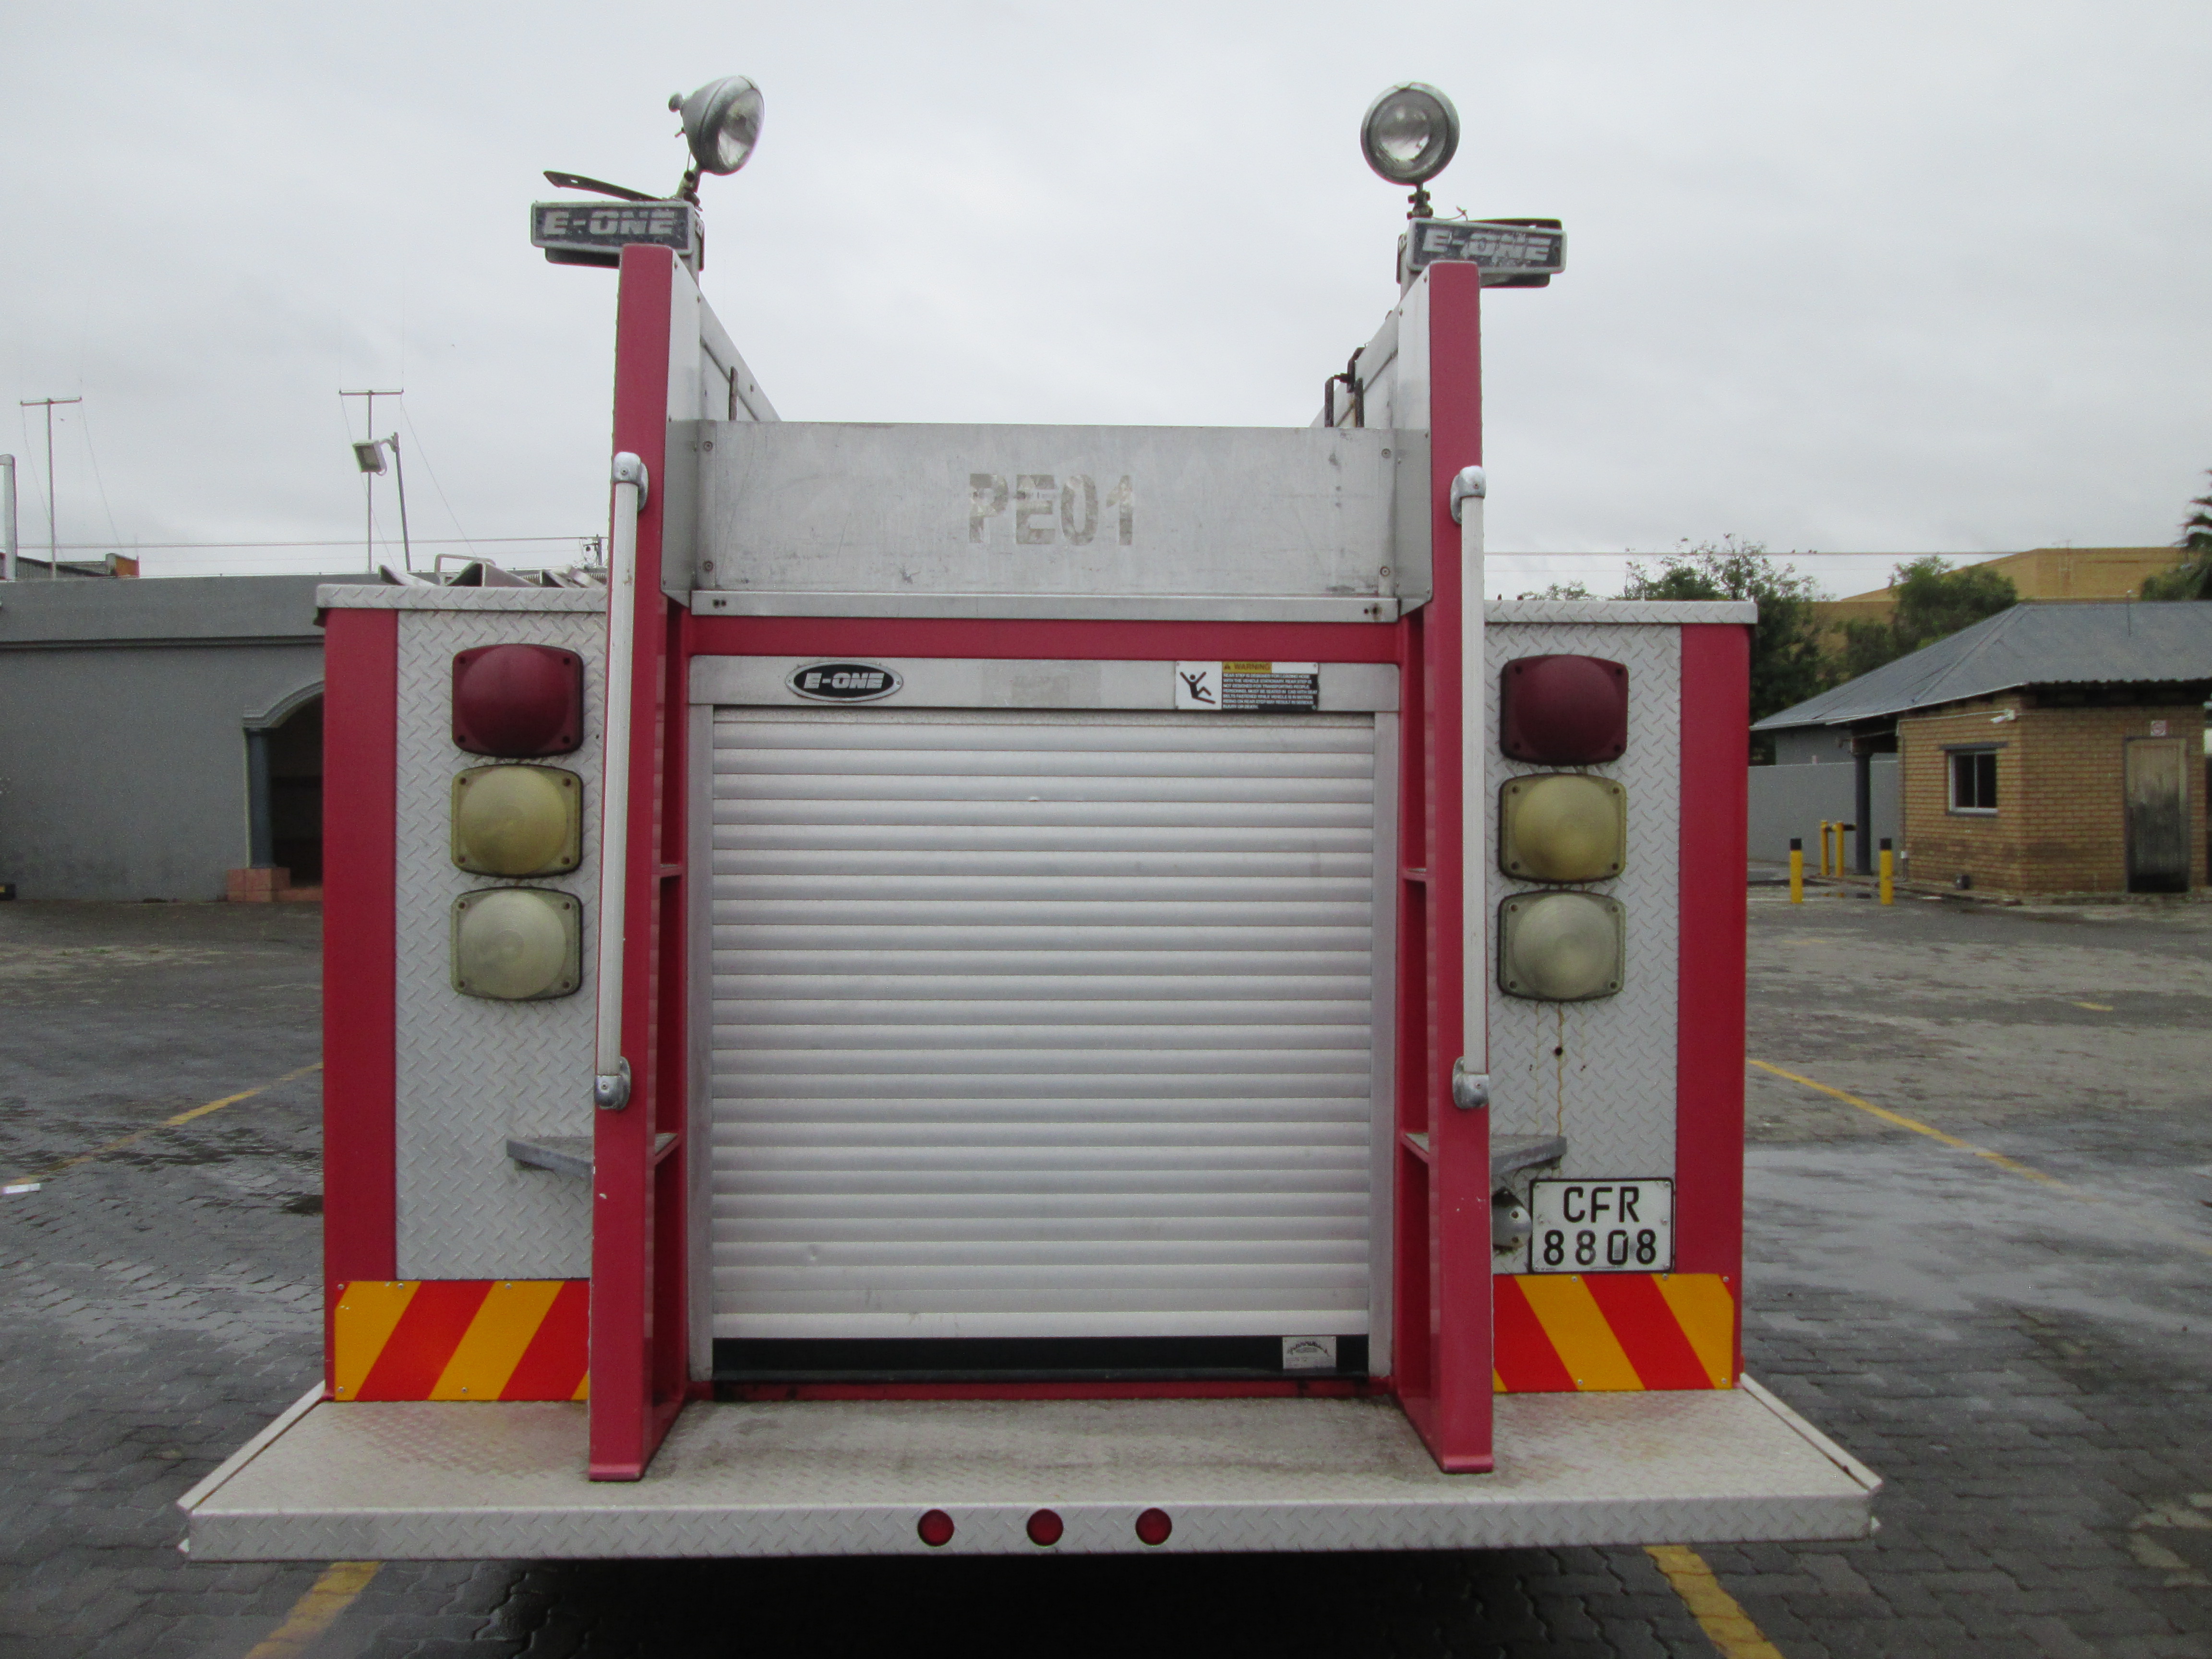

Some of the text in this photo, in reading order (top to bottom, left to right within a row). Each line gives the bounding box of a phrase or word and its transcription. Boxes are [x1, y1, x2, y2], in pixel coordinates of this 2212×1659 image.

[543, 210, 675, 235] E-ONE
[1422, 228, 1552, 261] E-ONE
[803, 672, 885, 689] E-ONE
[1563, 1186, 1640, 1223] CFR
[1543, 1229, 1657, 1266] 8808
